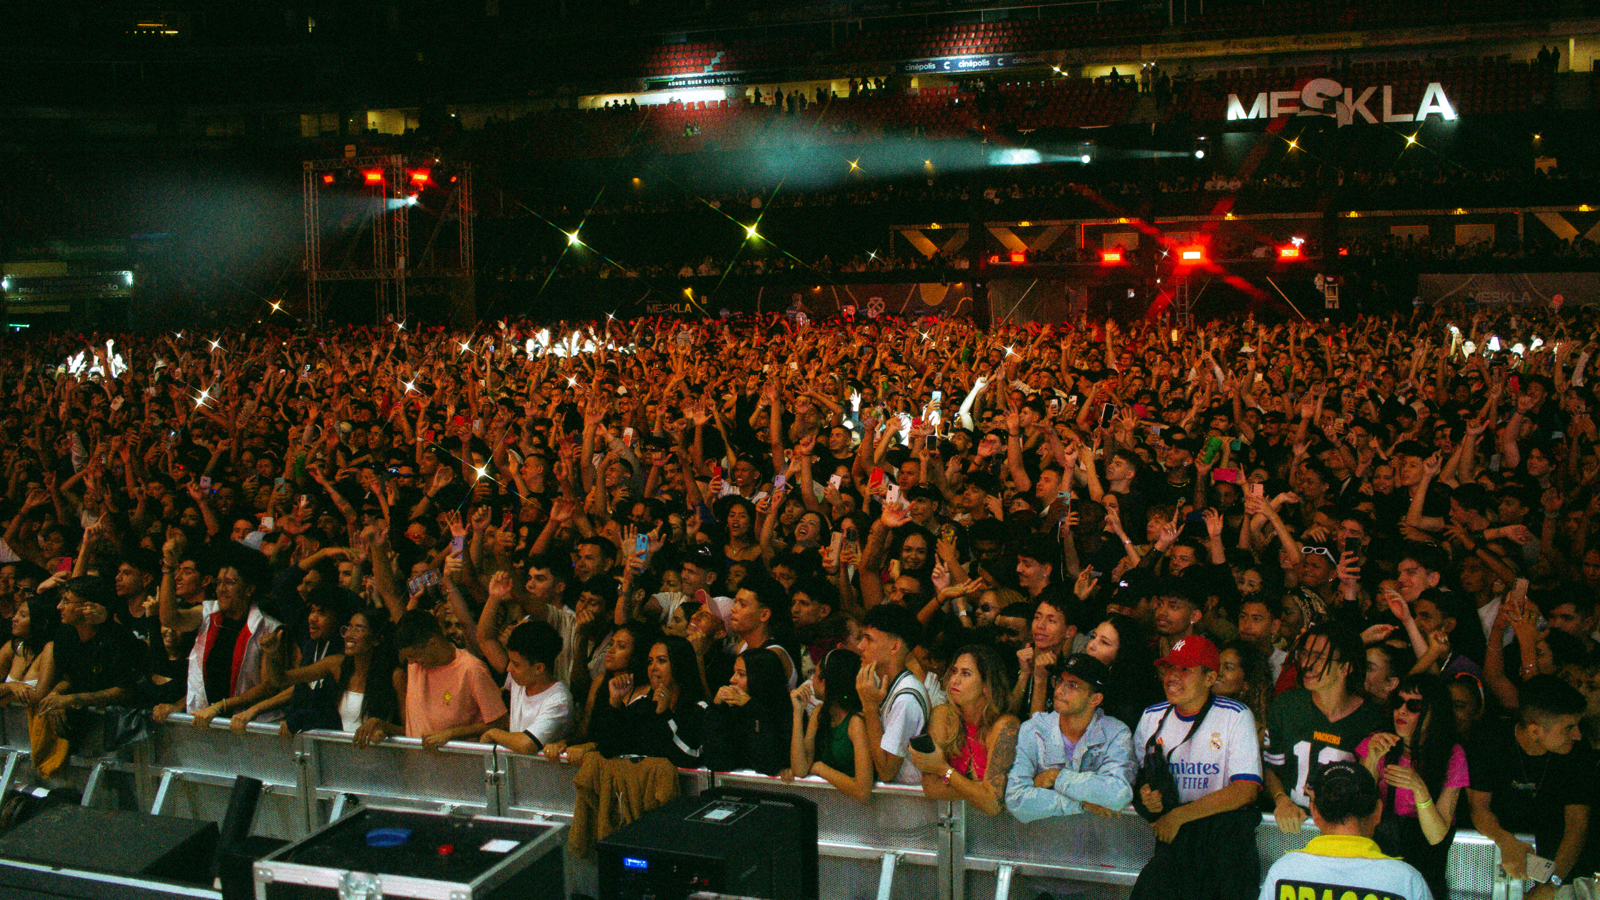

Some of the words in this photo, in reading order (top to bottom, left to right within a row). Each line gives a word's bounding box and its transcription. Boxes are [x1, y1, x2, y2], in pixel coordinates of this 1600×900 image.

[905, 62, 936, 72] cinépolis
[958, 58, 990, 68] cinépolis
[1313, 731, 1341, 746] PACKERS
[1167, 758, 1220, 775] mirates
[1290, 740, 1357, 808] 1
[1182, 776, 1209, 789] ETTER
